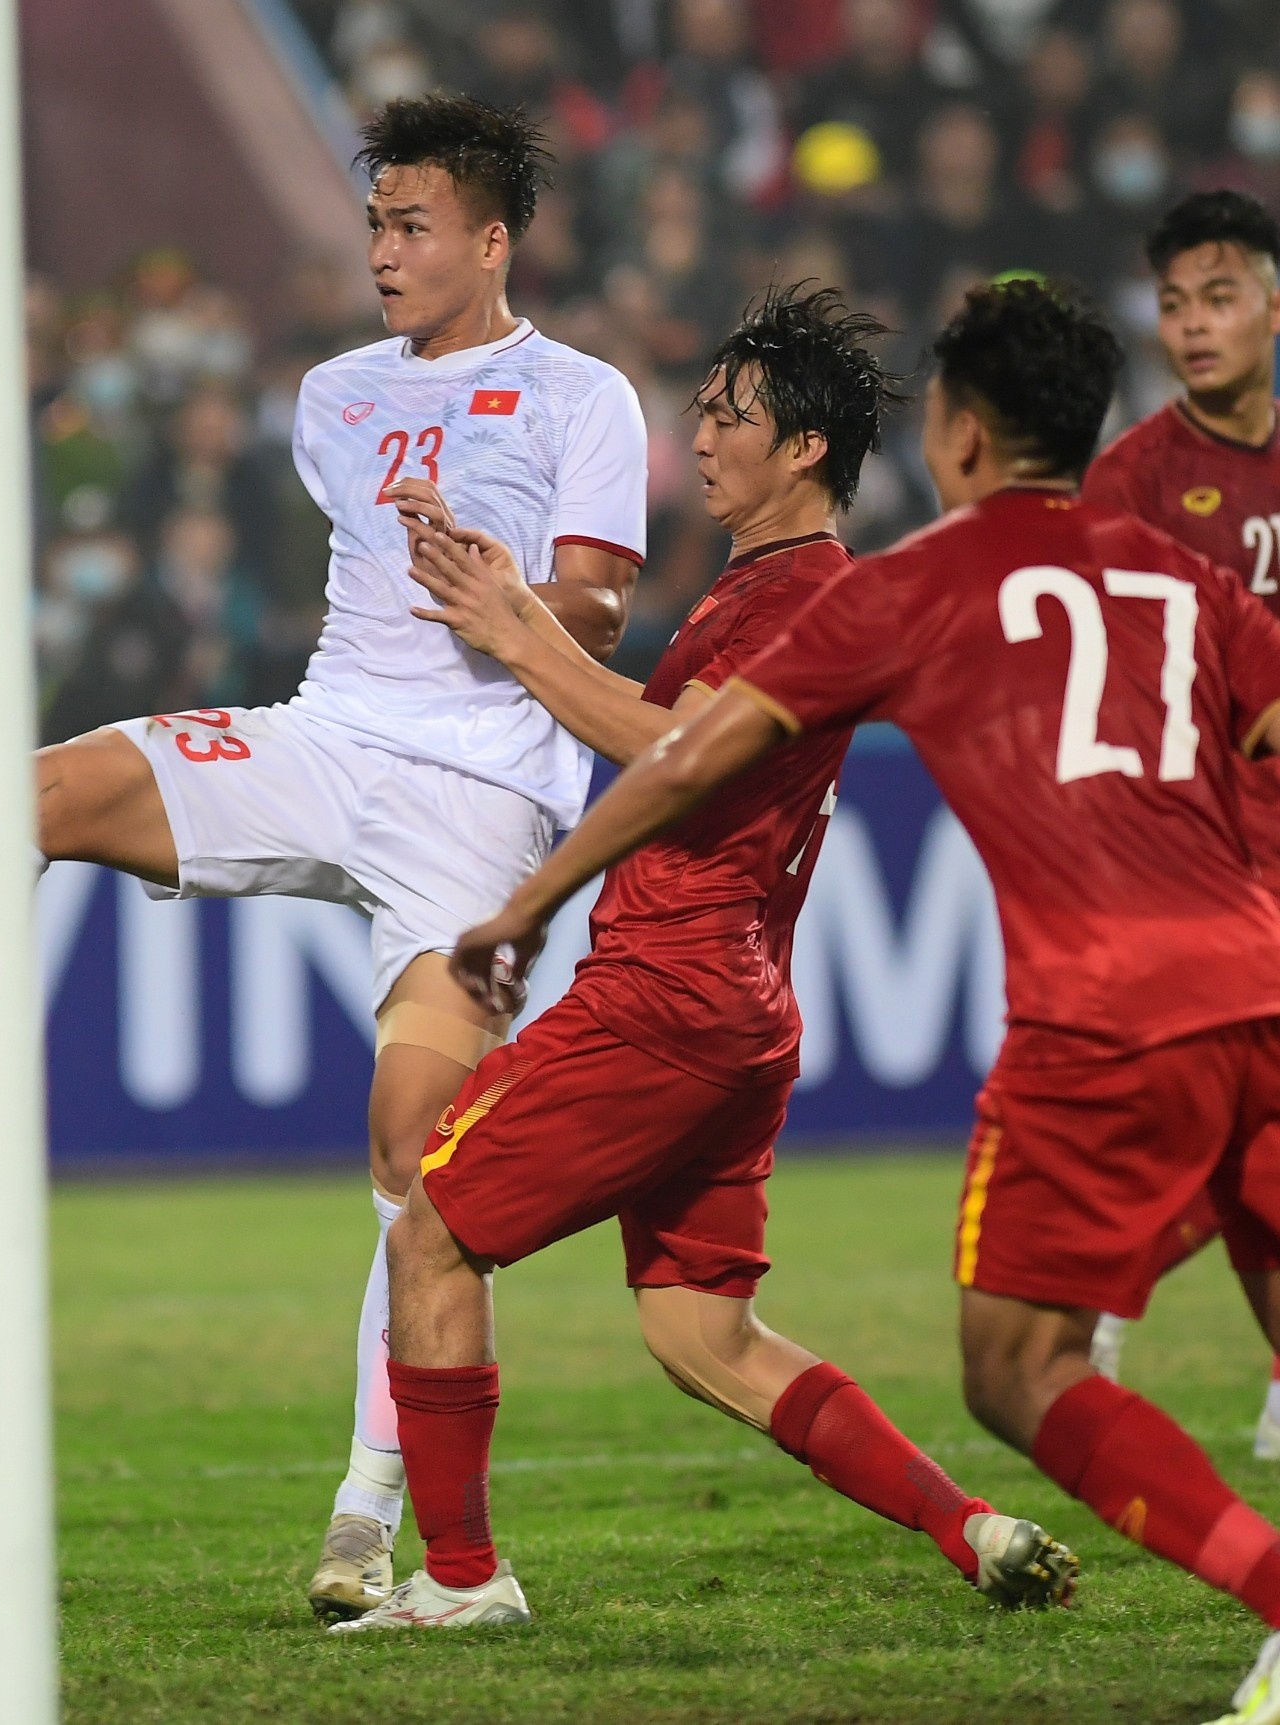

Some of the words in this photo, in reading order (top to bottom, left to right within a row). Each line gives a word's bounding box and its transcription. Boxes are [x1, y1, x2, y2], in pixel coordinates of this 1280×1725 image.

[375, 426, 443, 505] 23
[998, 565, 1200, 784] 27
[150, 708, 252, 763] 23
